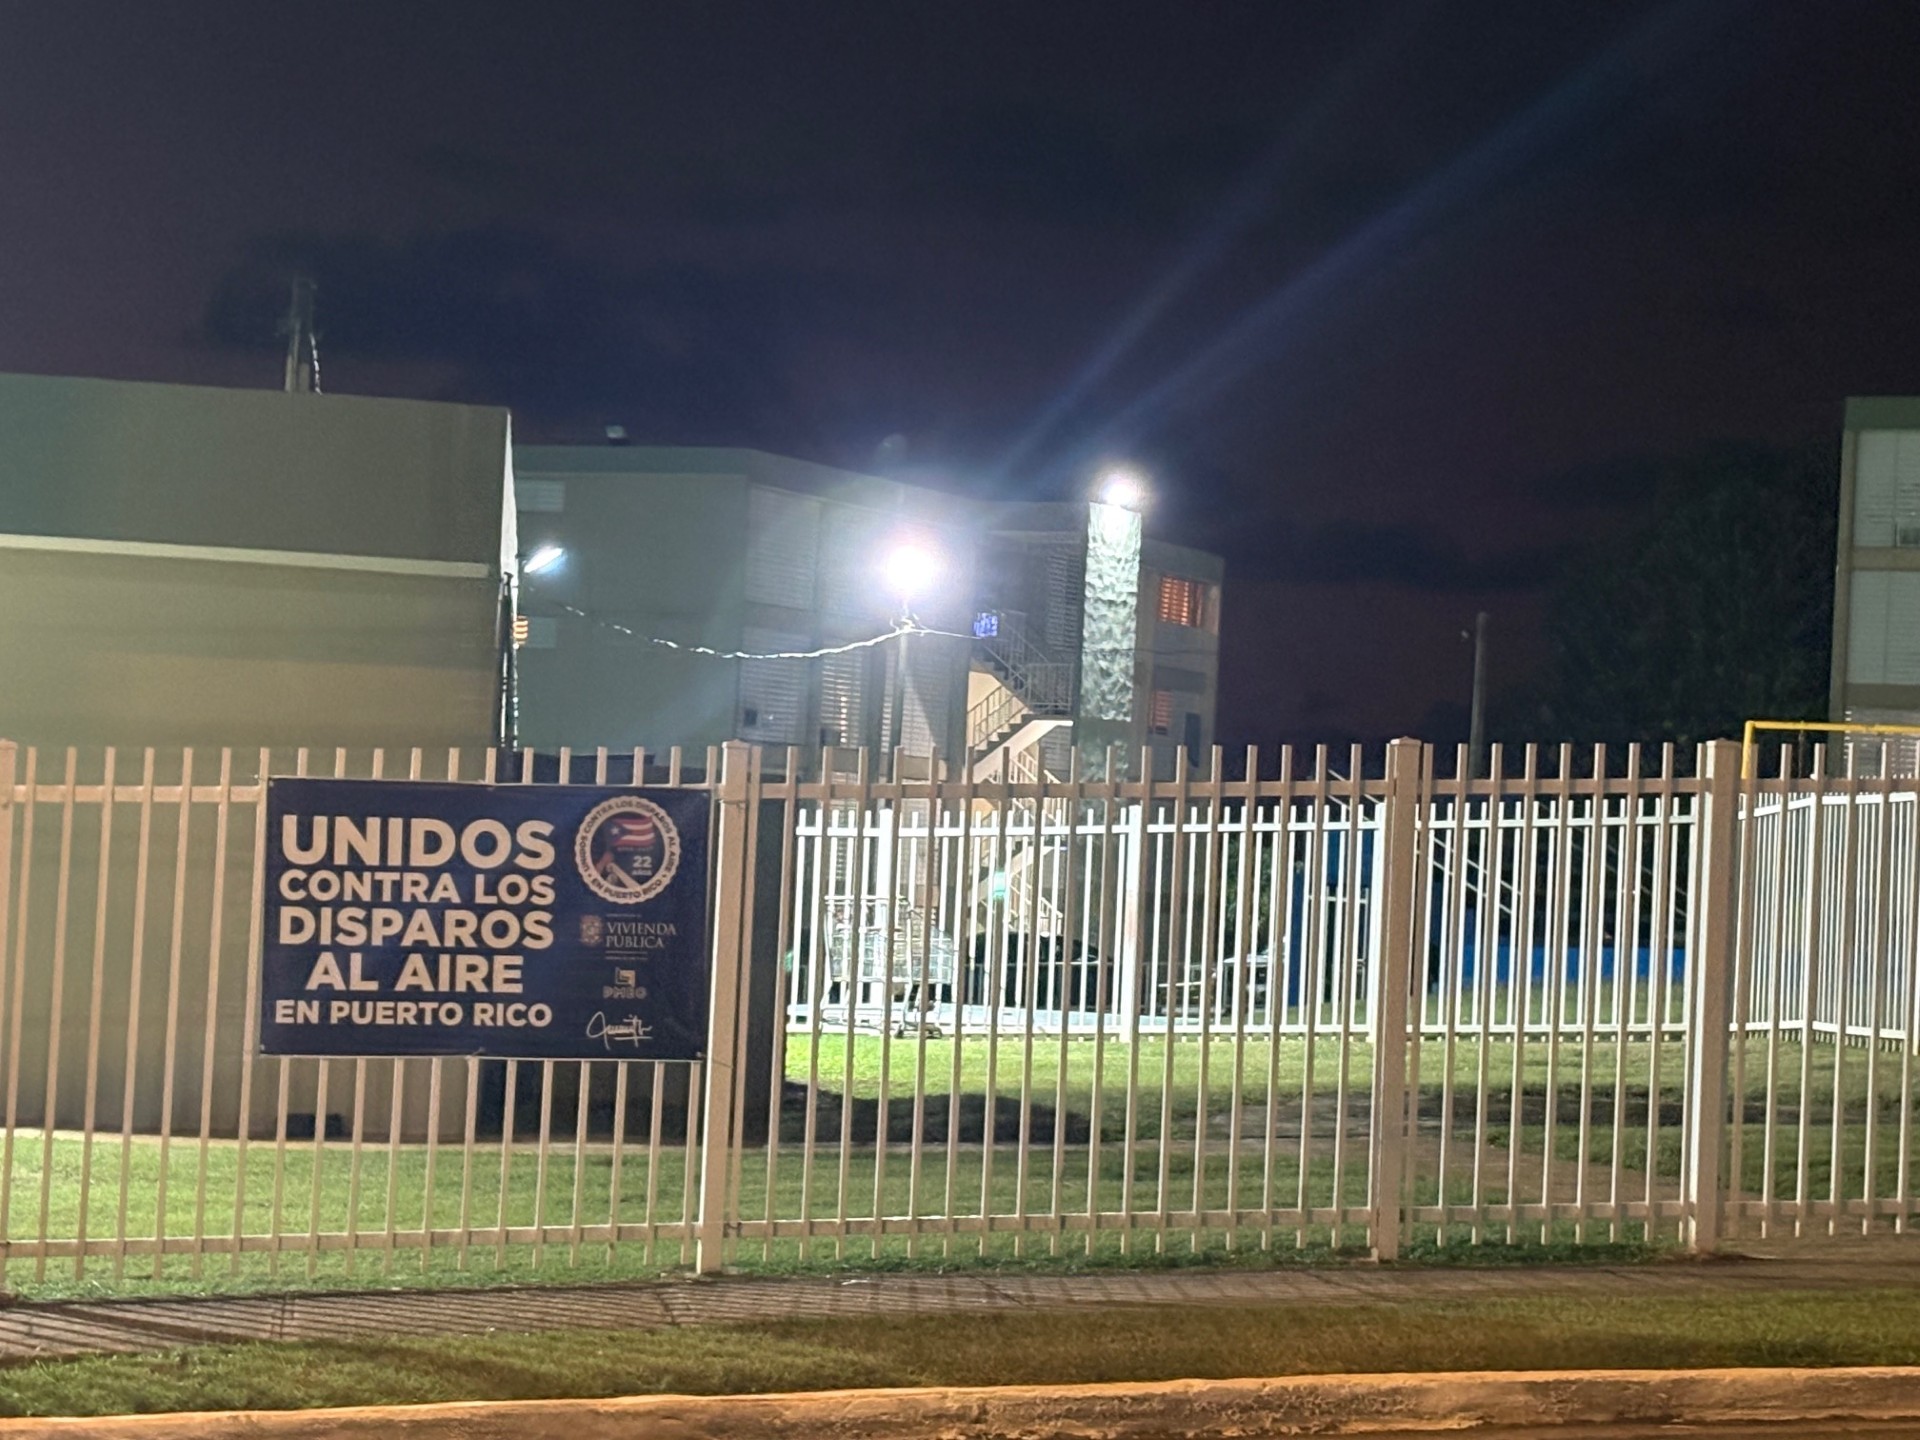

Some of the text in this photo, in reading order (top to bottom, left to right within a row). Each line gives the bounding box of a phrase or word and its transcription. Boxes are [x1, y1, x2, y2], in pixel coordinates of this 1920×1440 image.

[584, 803, 614, 834] CONTRA
[615, 799, 634, 809] LOS
[282, 814, 555, 870] UNIDOS
[631, 855, 653, 869] 22
[280, 868, 556, 906] CONTRA LOS
[279, 905, 554, 950] DISPAROS
[606, 921, 677, 937] VIVIENDA
[305, 951, 524, 994] AL AIRE
[275, 999, 553, 1028] EN PUERTO RICO
